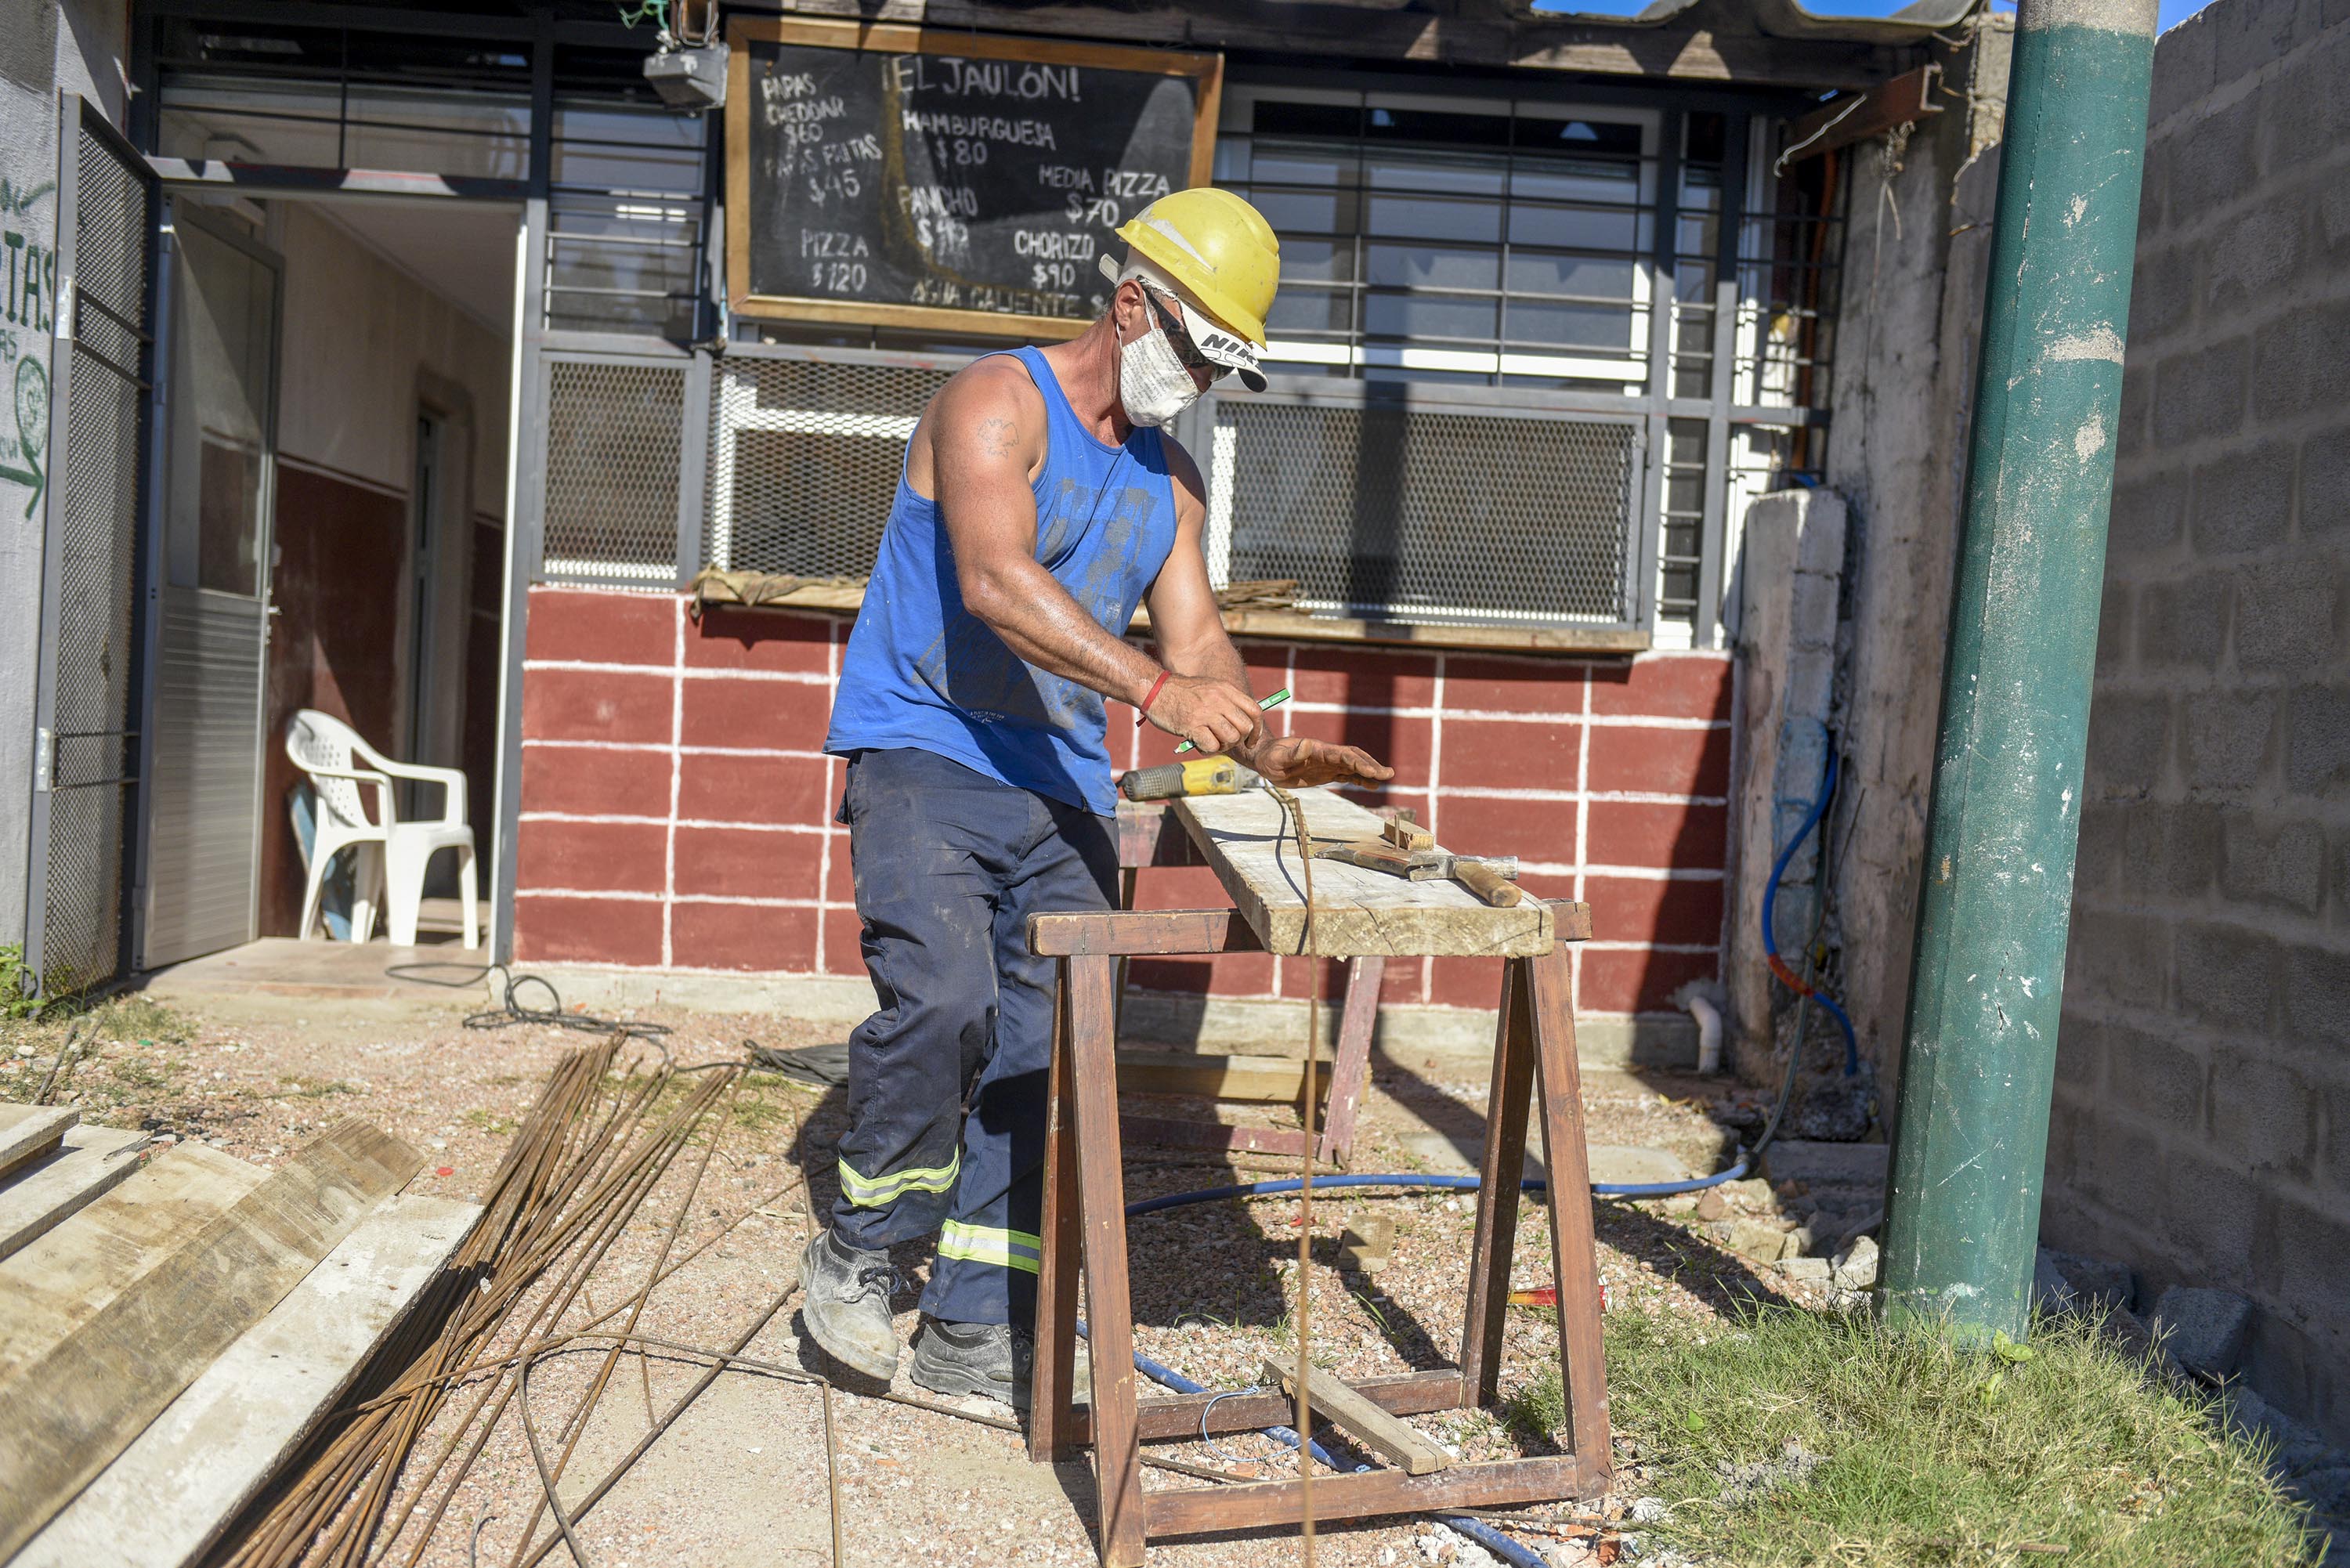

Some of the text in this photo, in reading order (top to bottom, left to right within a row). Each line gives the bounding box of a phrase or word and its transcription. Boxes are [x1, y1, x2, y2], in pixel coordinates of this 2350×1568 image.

[761, 72, 816, 100] PAPAS
[902, 110, 1057, 151] HAMBURGUESA
[1038, 164, 1170, 197] MEDIA PIZZA
[897, 183, 978, 216] PANCHO
[1065, 191, 1120, 227] $70
[801, 227, 869, 258] PIZZA
[1014, 229, 1095, 260] CHORIZO
[1032, 262, 1076, 289] $90
